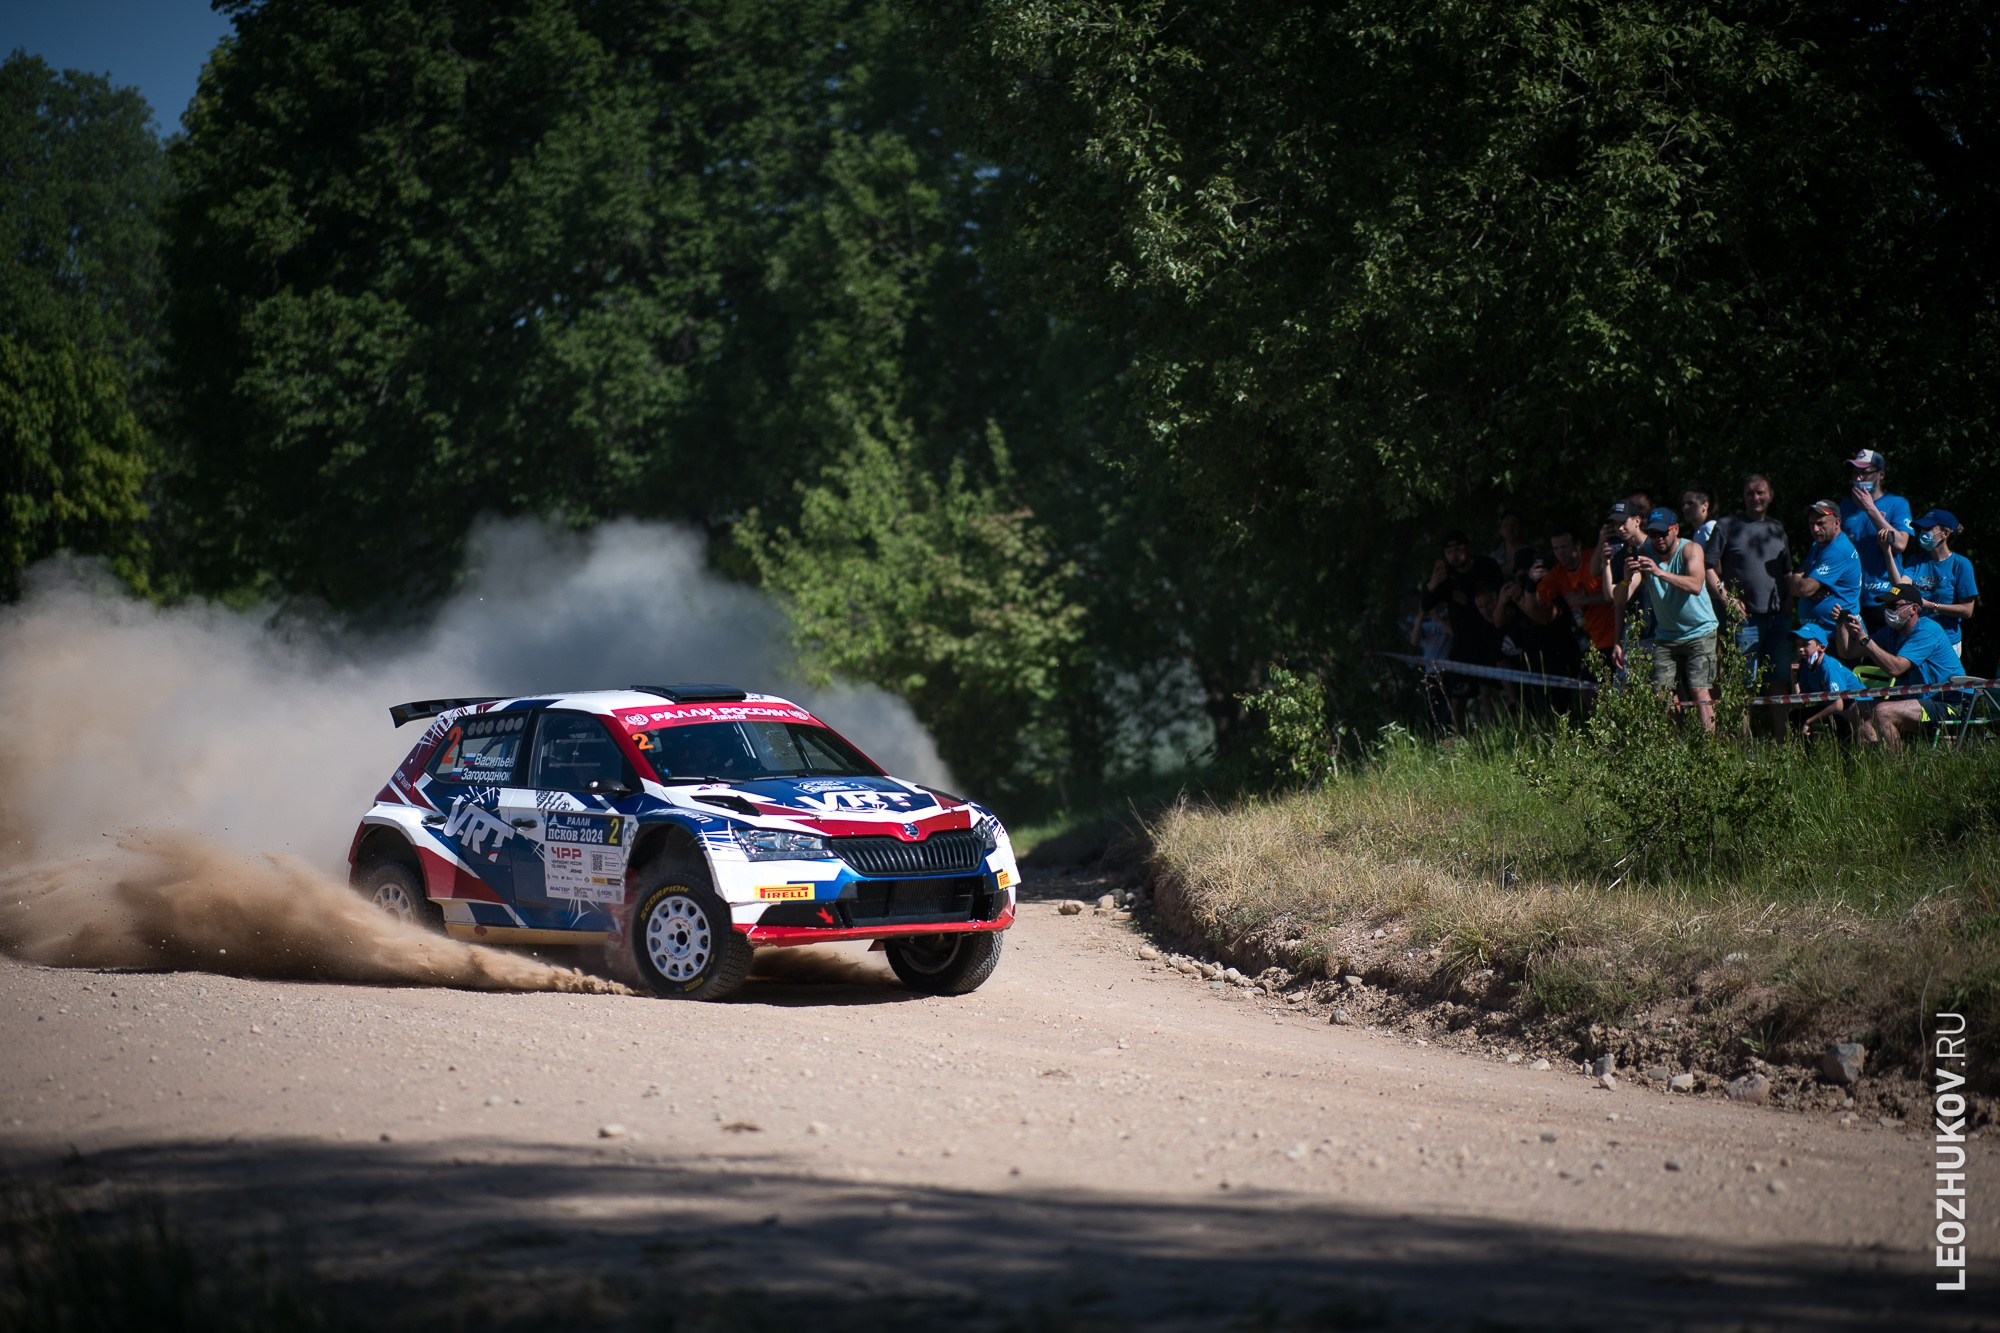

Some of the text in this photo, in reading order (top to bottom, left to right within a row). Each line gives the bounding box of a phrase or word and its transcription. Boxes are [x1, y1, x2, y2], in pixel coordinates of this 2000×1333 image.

[650, 707, 789, 721] РАЛЛИ РОССИИ
[441, 725, 462, 764] 2
[631, 733, 654, 750] 2
[474, 753, 515, 768] Васильев
[461, 768, 512, 784] Загороднюк
[795, 790, 912, 811] VRT
[443, 794, 516, 863] VRT
[566, 816, 591, 826] РАЛЛИ
[547, 828, 604, 843] ПСКОВ 2024
[608, 818, 620, 844] 2
[551, 847, 582, 860] ЧРР
[760, 887, 808, 899] PIRELLI
[640, 885, 689, 921] SCORPION
